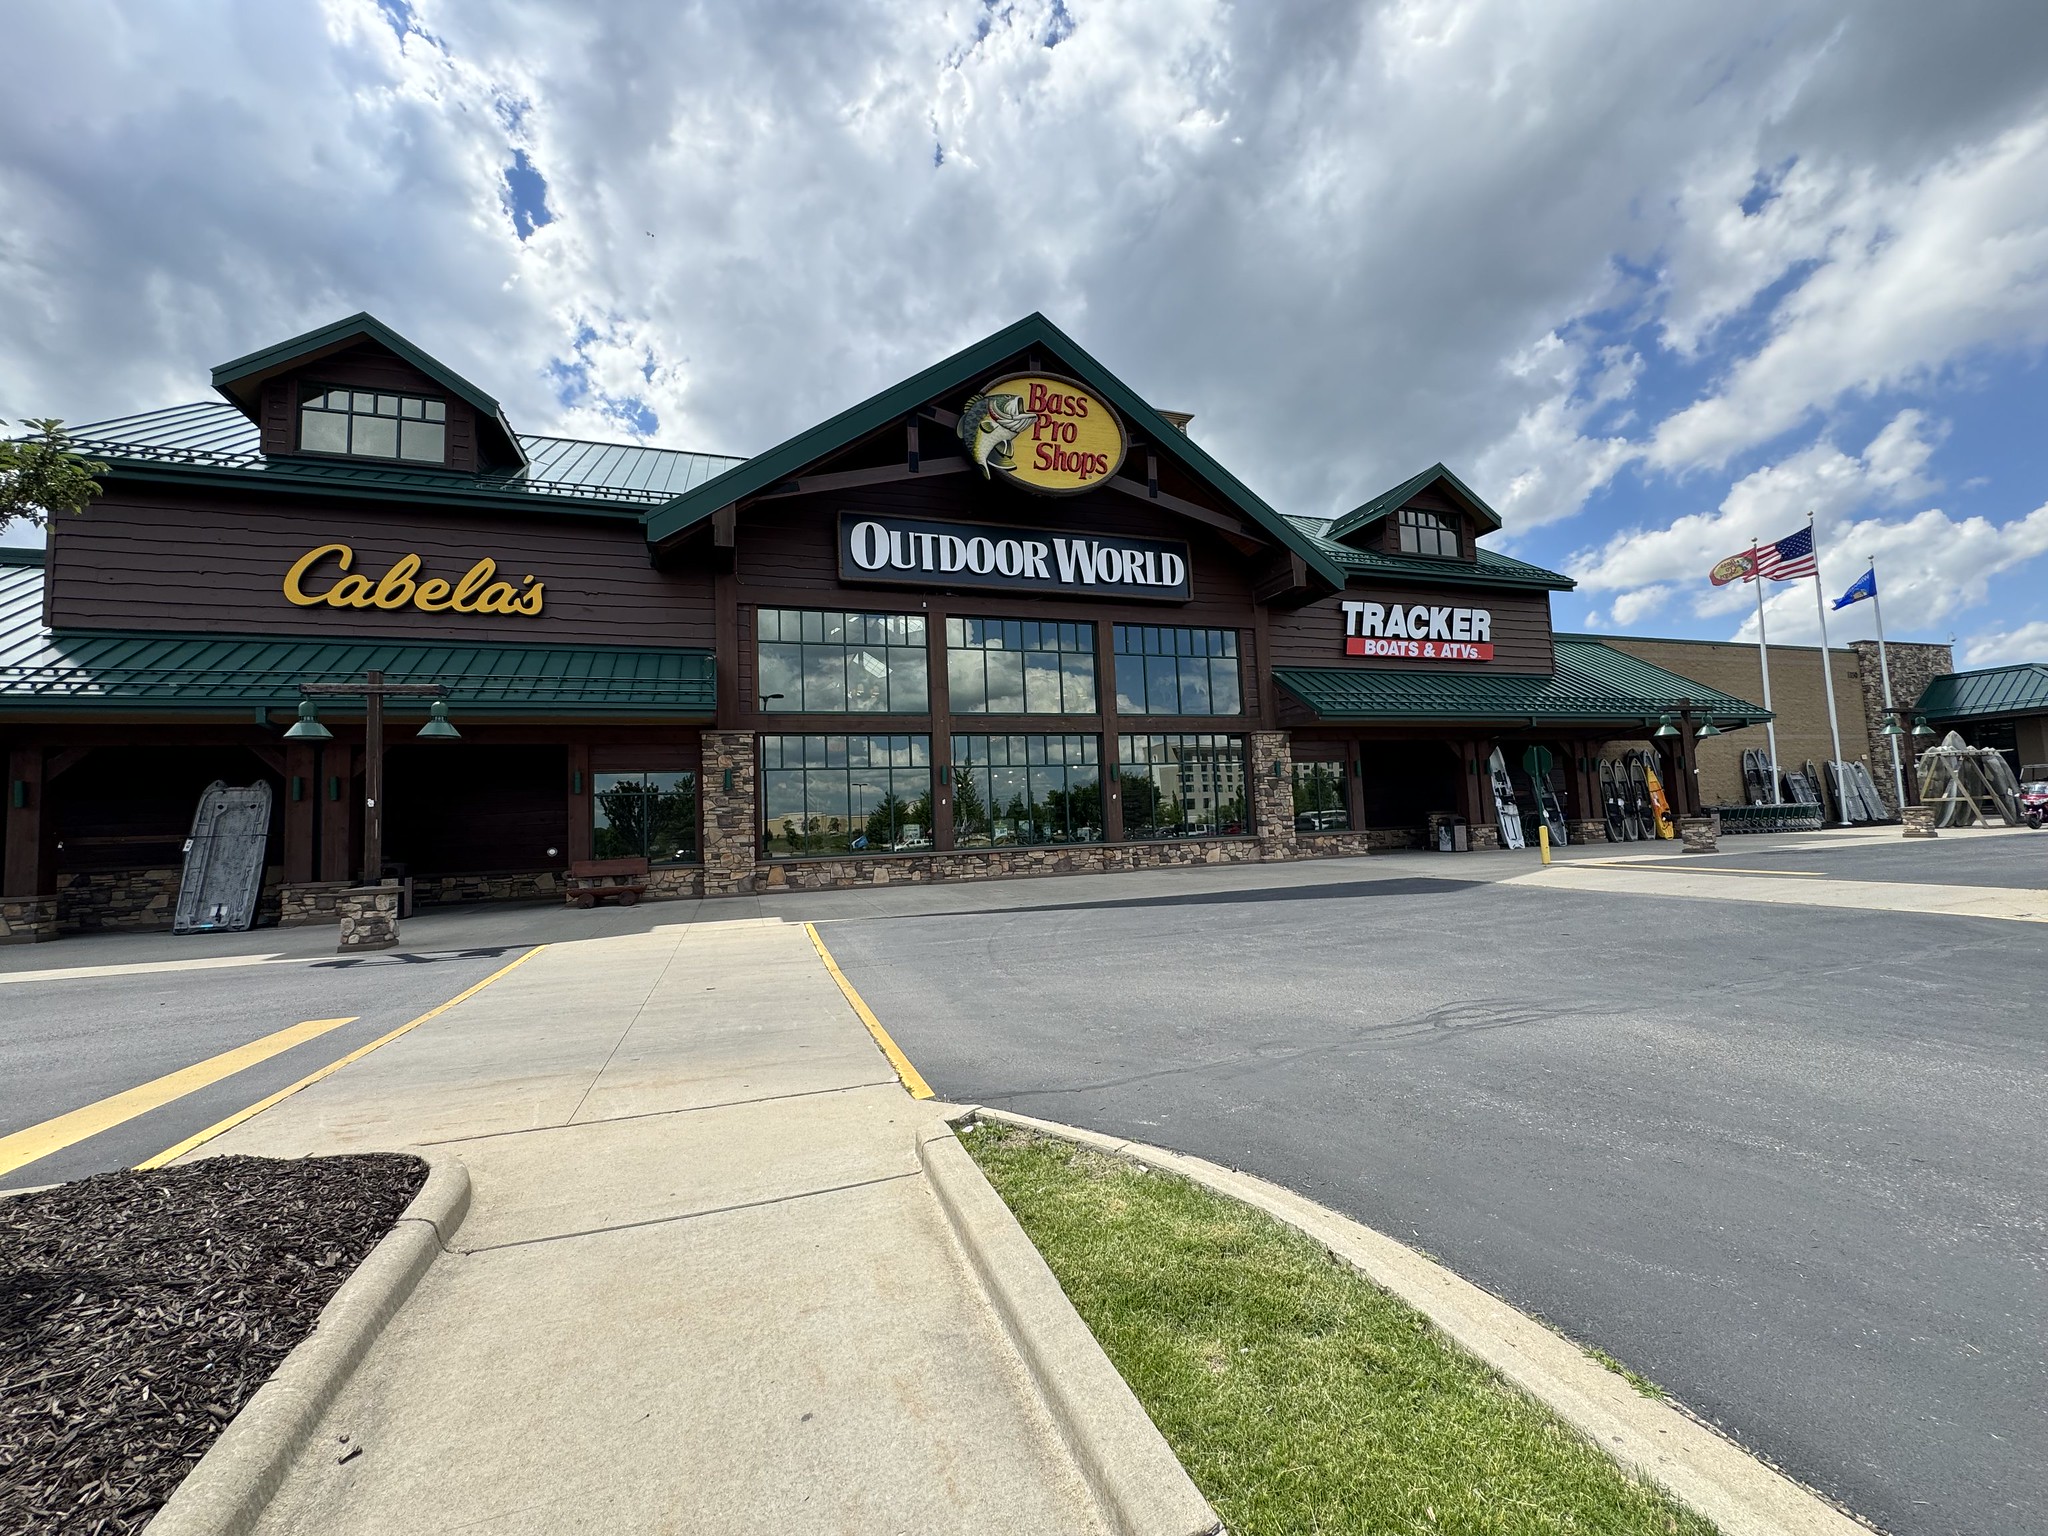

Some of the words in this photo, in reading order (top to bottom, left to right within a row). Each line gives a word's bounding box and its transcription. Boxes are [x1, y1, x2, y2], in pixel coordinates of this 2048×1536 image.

[1026, 382, 1088, 418] Bass
[1031, 413, 1078, 444] Pro
[1033, 442, 1108, 480] Shops
[850, 521, 1051, 579] OUTDOOR
[1052, 538, 1185, 587] WORLD
[283, 543, 545, 616] Cabela's
[1342, 601, 1491, 642] TRACKER
[1364, 639, 1419, 657] BOATS
[1423, 642, 1436, 658] &
[1440, 643, 1479, 660] ATVs
